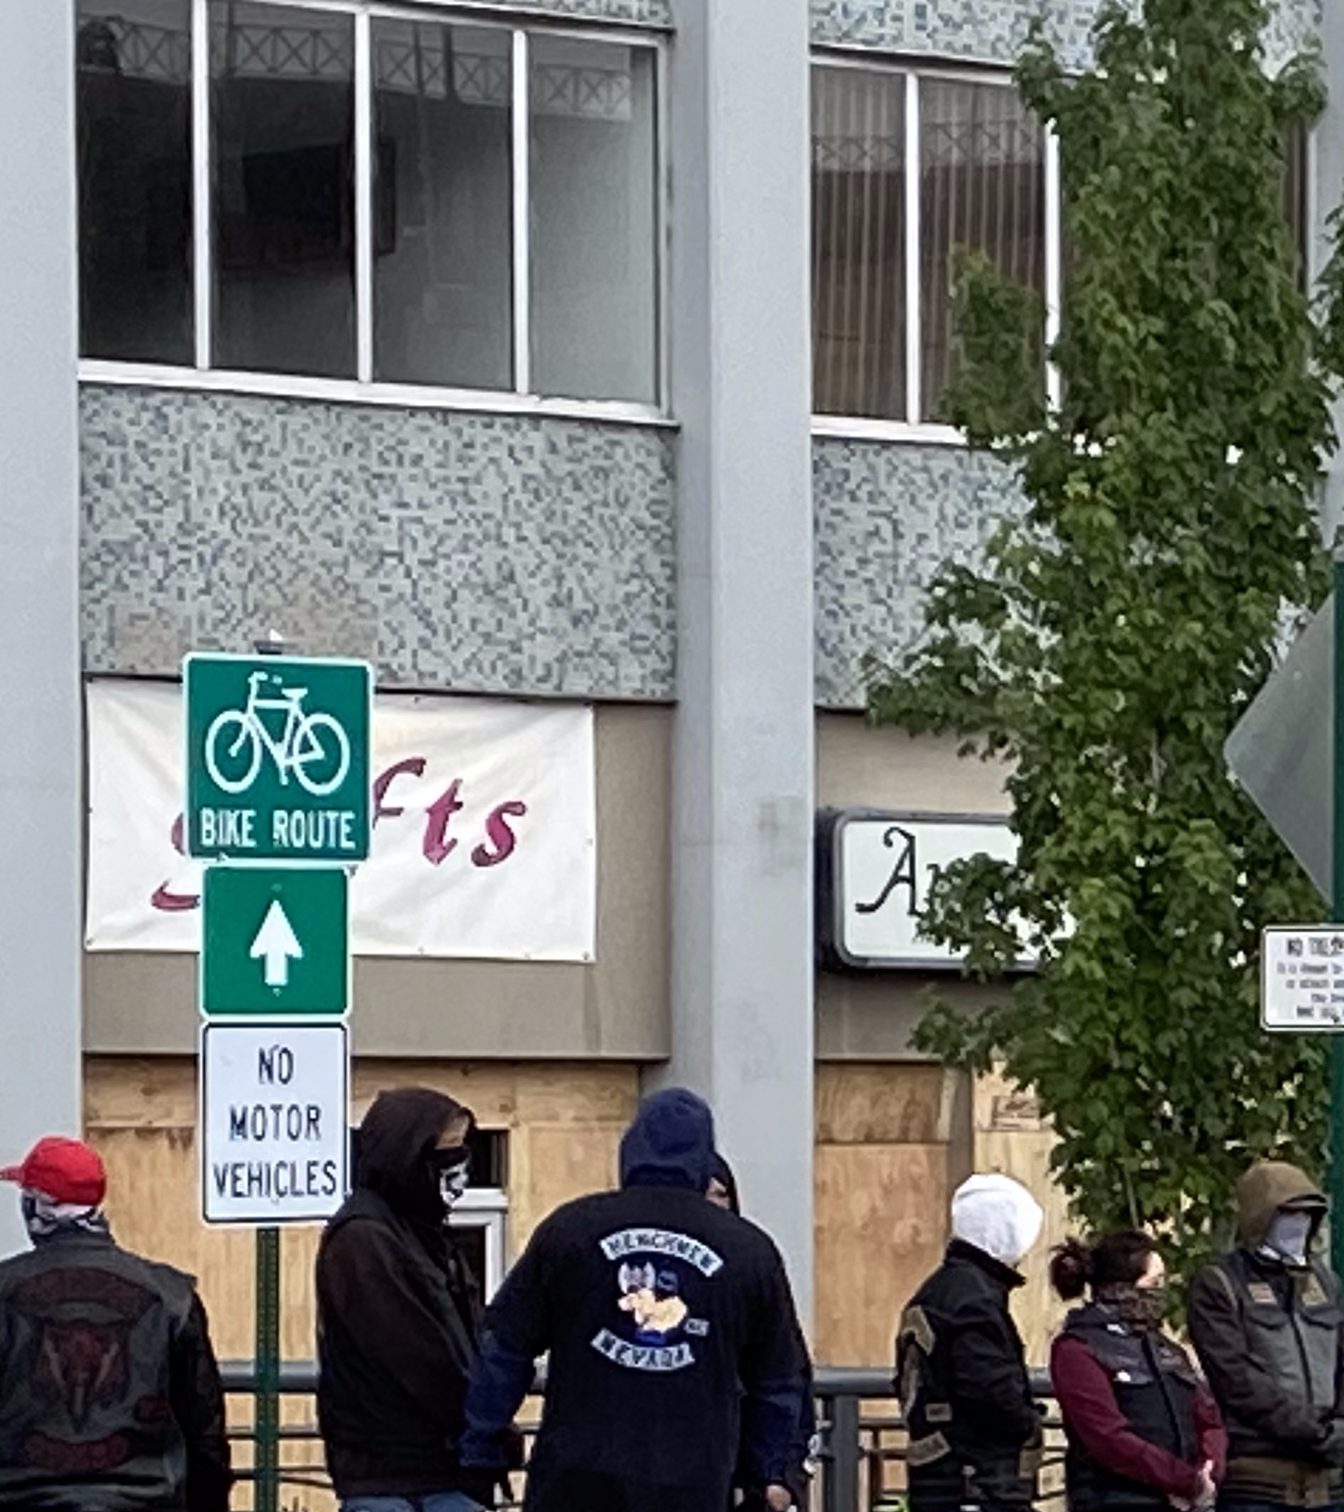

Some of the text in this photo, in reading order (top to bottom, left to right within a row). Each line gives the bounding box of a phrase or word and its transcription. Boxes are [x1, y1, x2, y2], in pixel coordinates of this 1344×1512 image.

[201, 808, 356, 849] BIKE ROUTE
[258, 1046, 294, 1086] NO
[229, 1103, 322, 1142] MOTOR
[213, 1159, 337, 1199] VEHICLES
